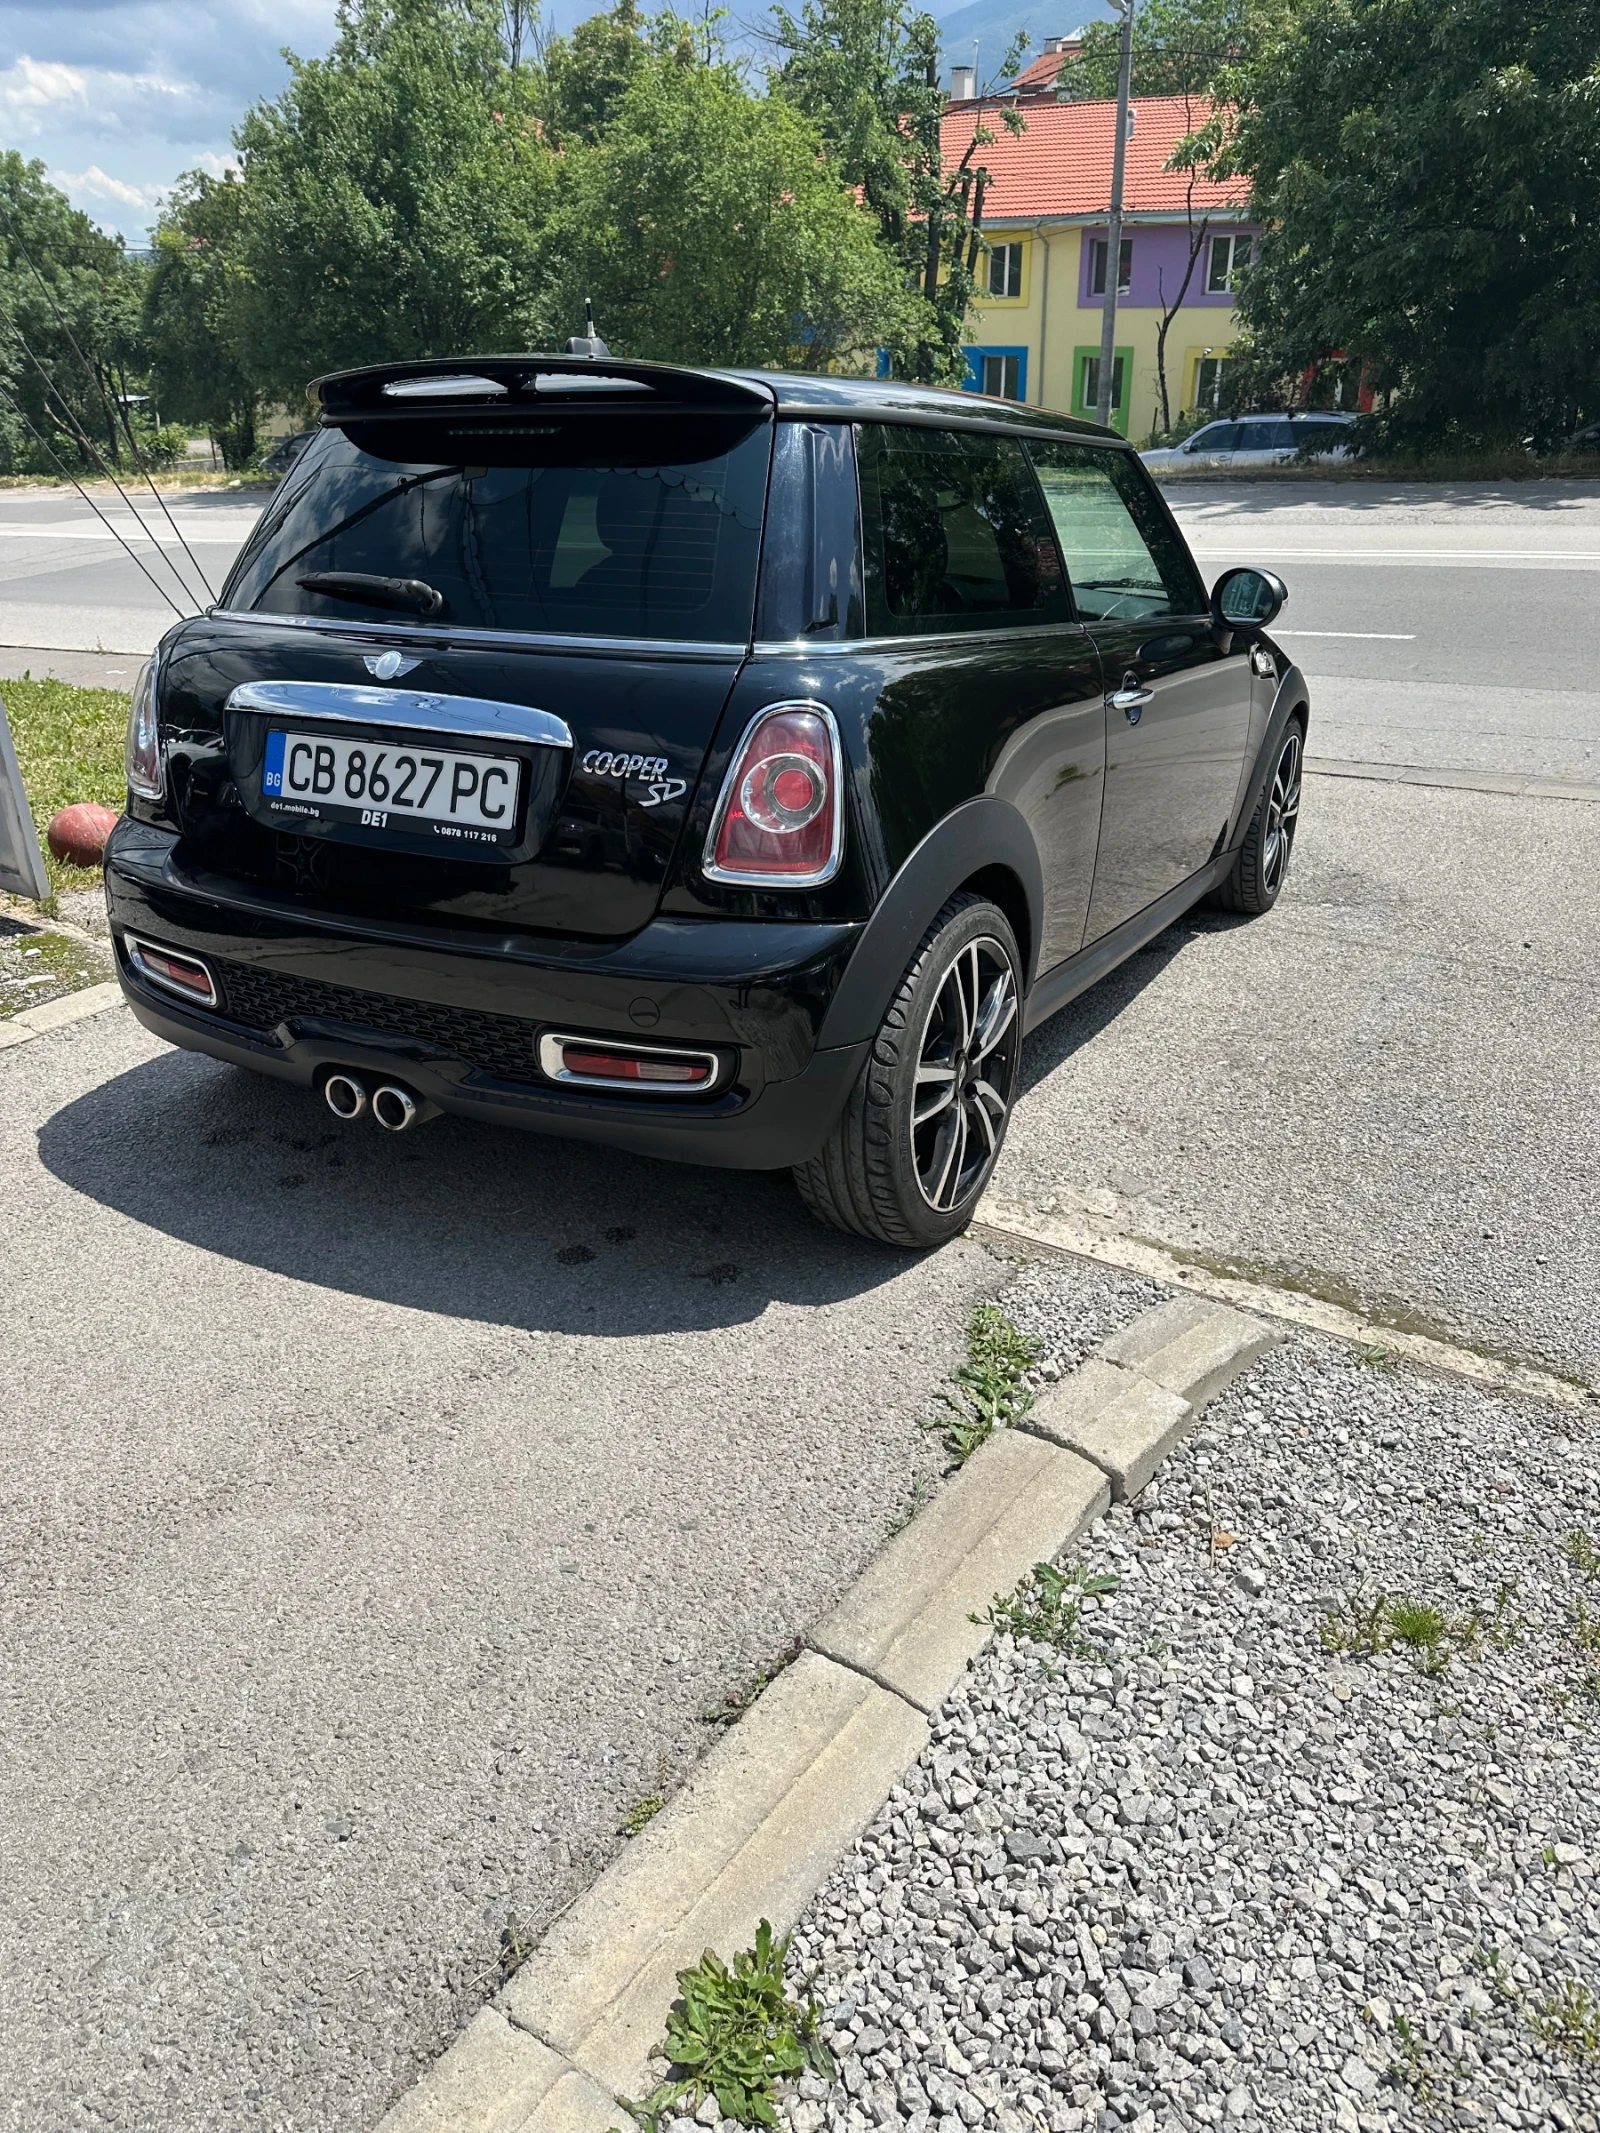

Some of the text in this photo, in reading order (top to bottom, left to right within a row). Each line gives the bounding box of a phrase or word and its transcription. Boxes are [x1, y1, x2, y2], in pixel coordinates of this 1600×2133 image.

[582, 749, 668, 782] COOPER
[266, 743, 508, 819] BG CB 8627 PC
[638, 778, 687, 807] SD
[270, 801, 320, 818] de1.mobile.bg
[361, 810, 388, 828] DE1
[441, 827, 497, 843] 0878 117 216
